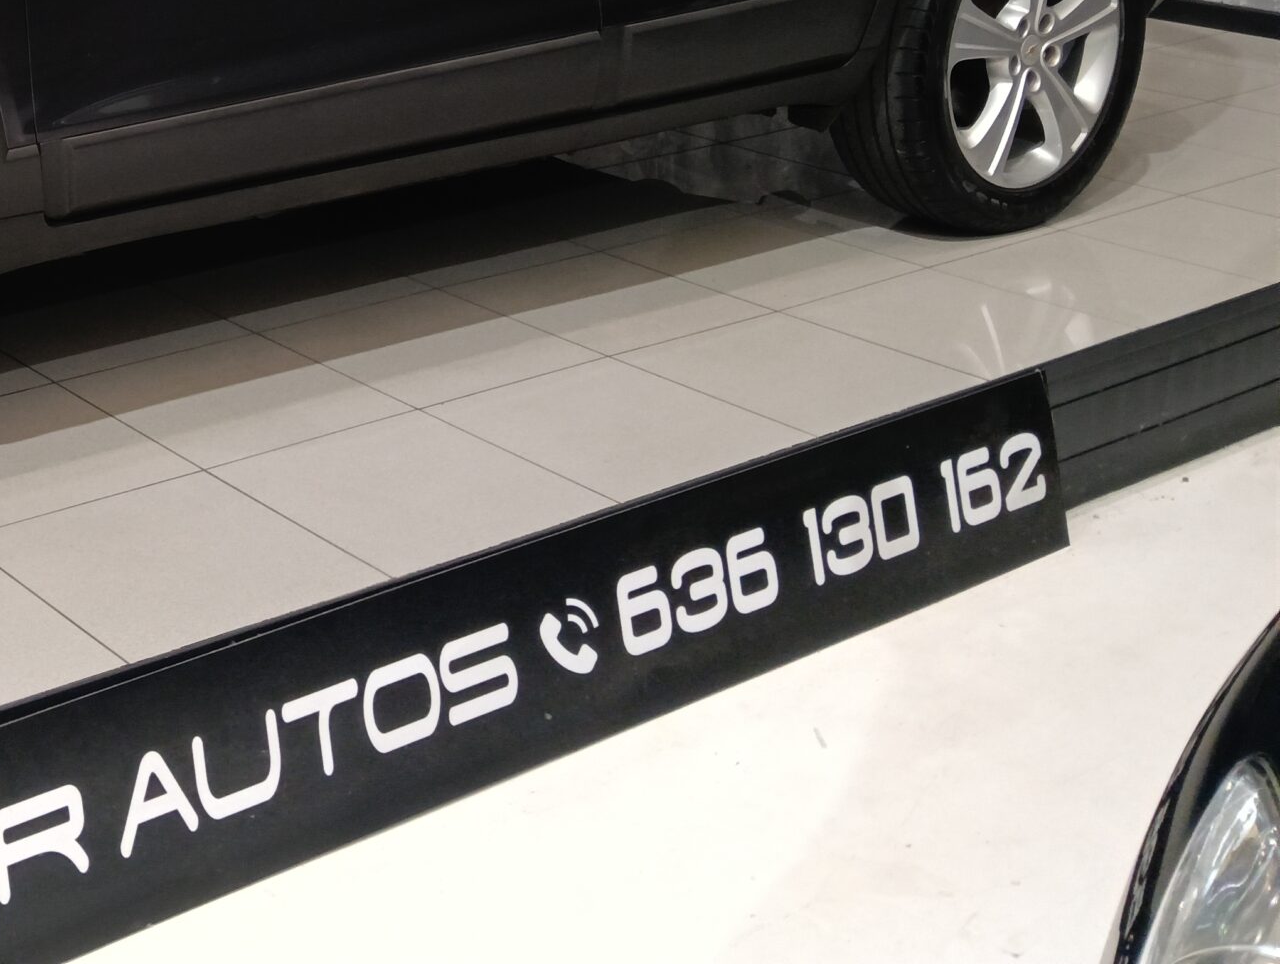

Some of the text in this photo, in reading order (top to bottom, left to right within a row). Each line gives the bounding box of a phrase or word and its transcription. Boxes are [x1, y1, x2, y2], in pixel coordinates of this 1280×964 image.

[120, 622, 519, 859] AUTOS
[616, 527, 779, 656] 636
[802, 475, 920, 586] 130
[940, 432, 1047, 533] 162
